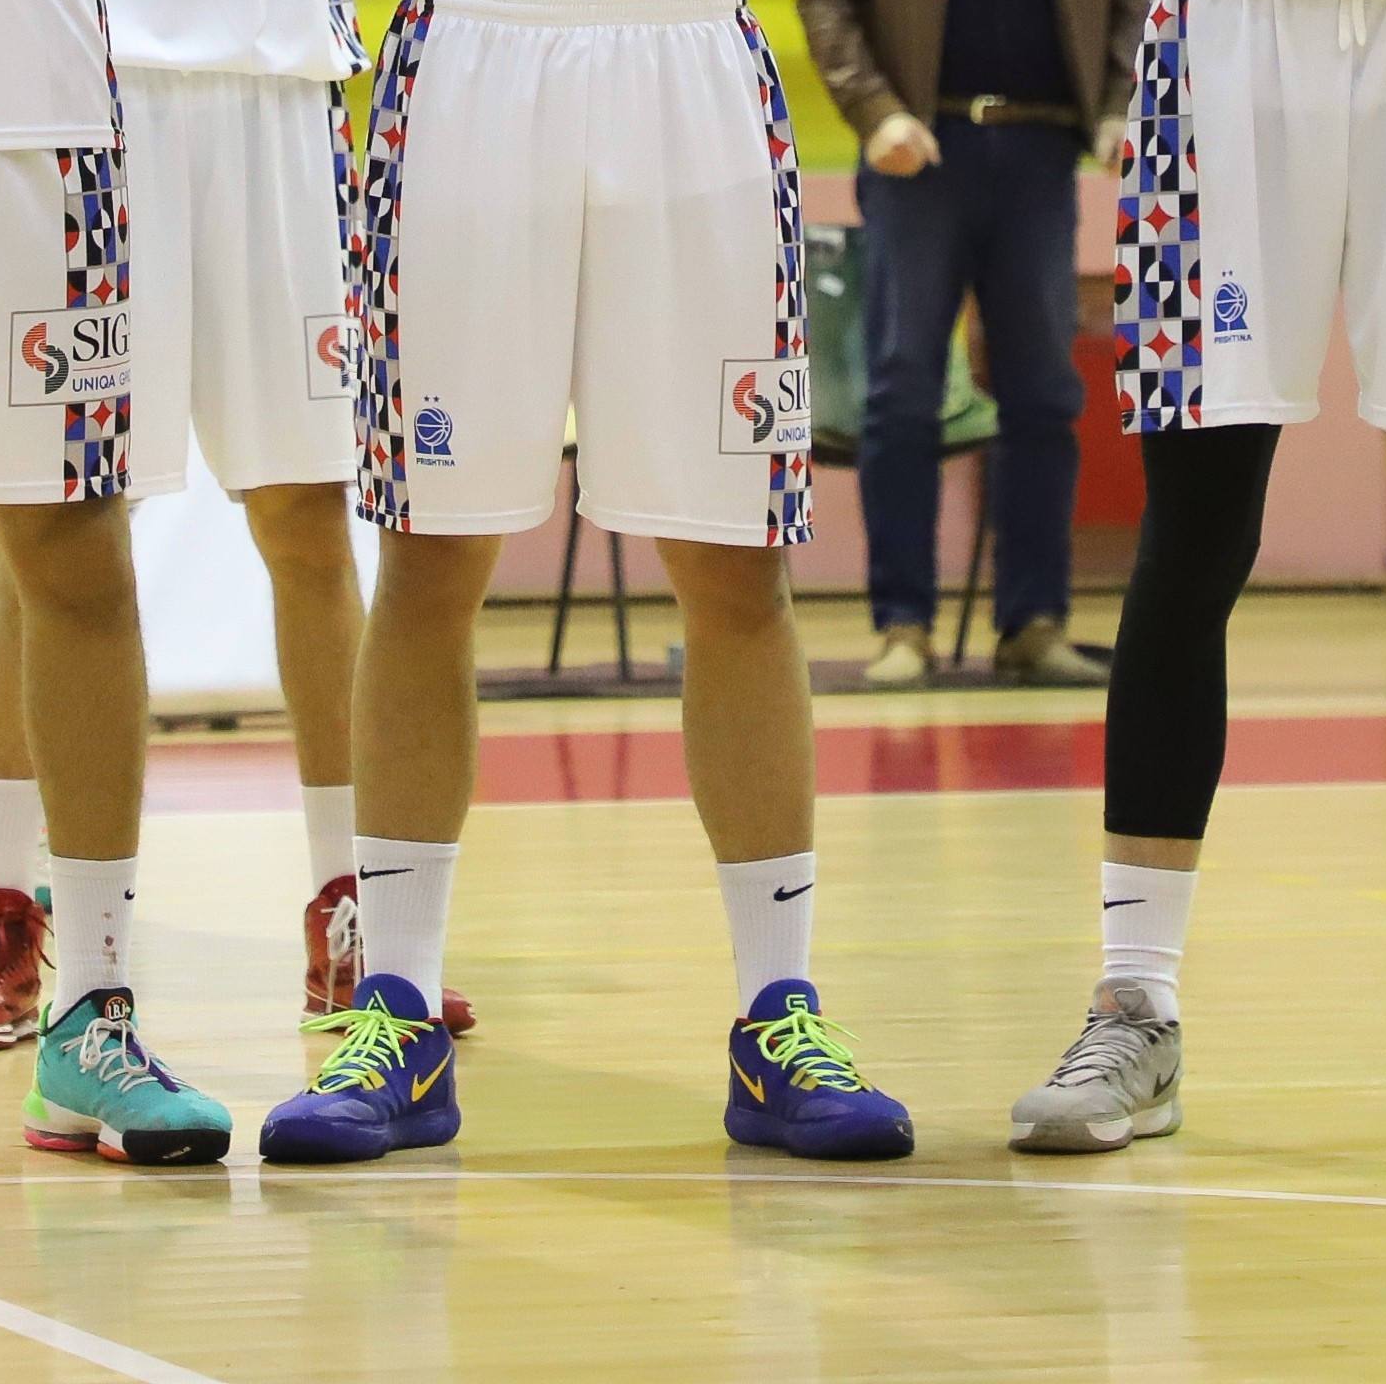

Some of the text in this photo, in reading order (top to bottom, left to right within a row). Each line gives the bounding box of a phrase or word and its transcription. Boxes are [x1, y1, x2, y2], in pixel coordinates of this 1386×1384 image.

[73, 312, 130, 362] SIG
[72, 375, 116, 392] UNIQA
[776, 426, 806, 443] UNIQA
[416, 457, 456, 467] PRISHTINA
